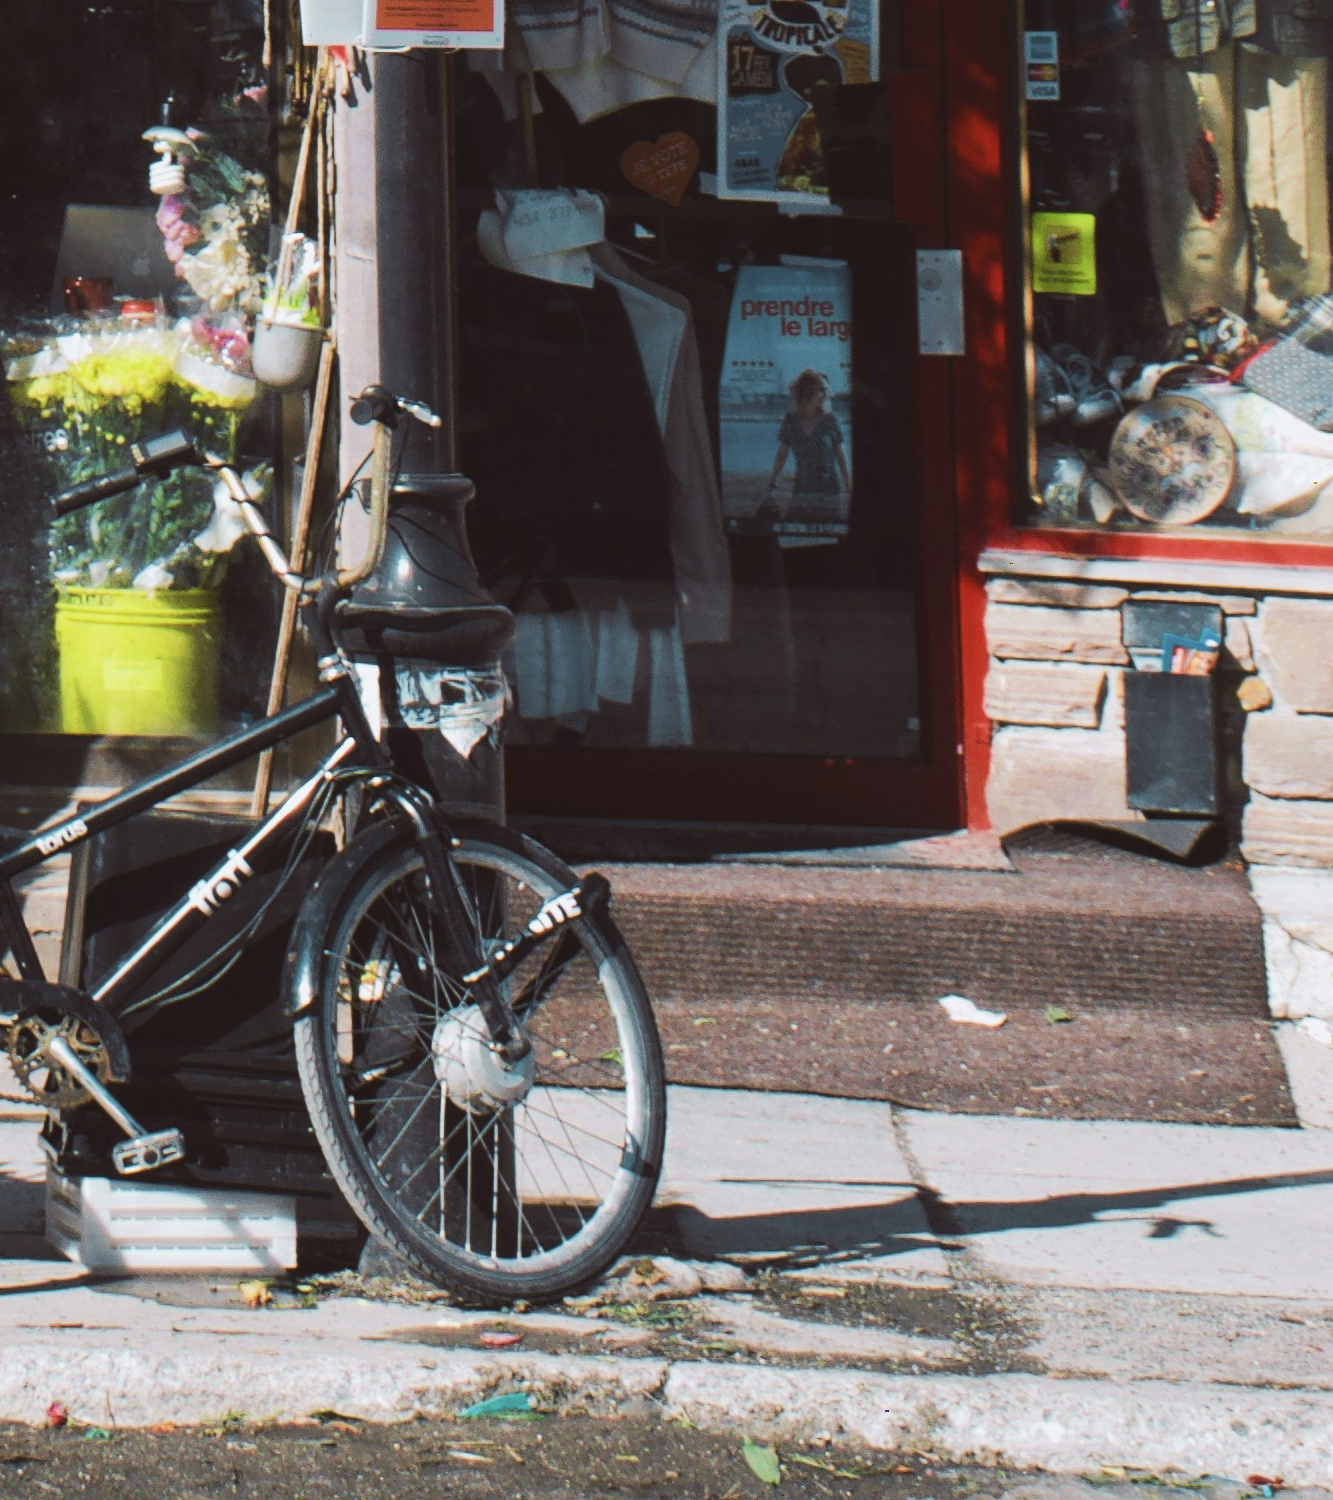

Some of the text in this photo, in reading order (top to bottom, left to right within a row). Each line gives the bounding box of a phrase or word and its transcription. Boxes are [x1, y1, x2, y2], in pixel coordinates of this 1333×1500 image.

[754, 14, 845, 47] TROPICALE
[740, 295, 834, 320] prendre
[781, 317, 801, 337] le
[807, 317, 853, 341] larg
